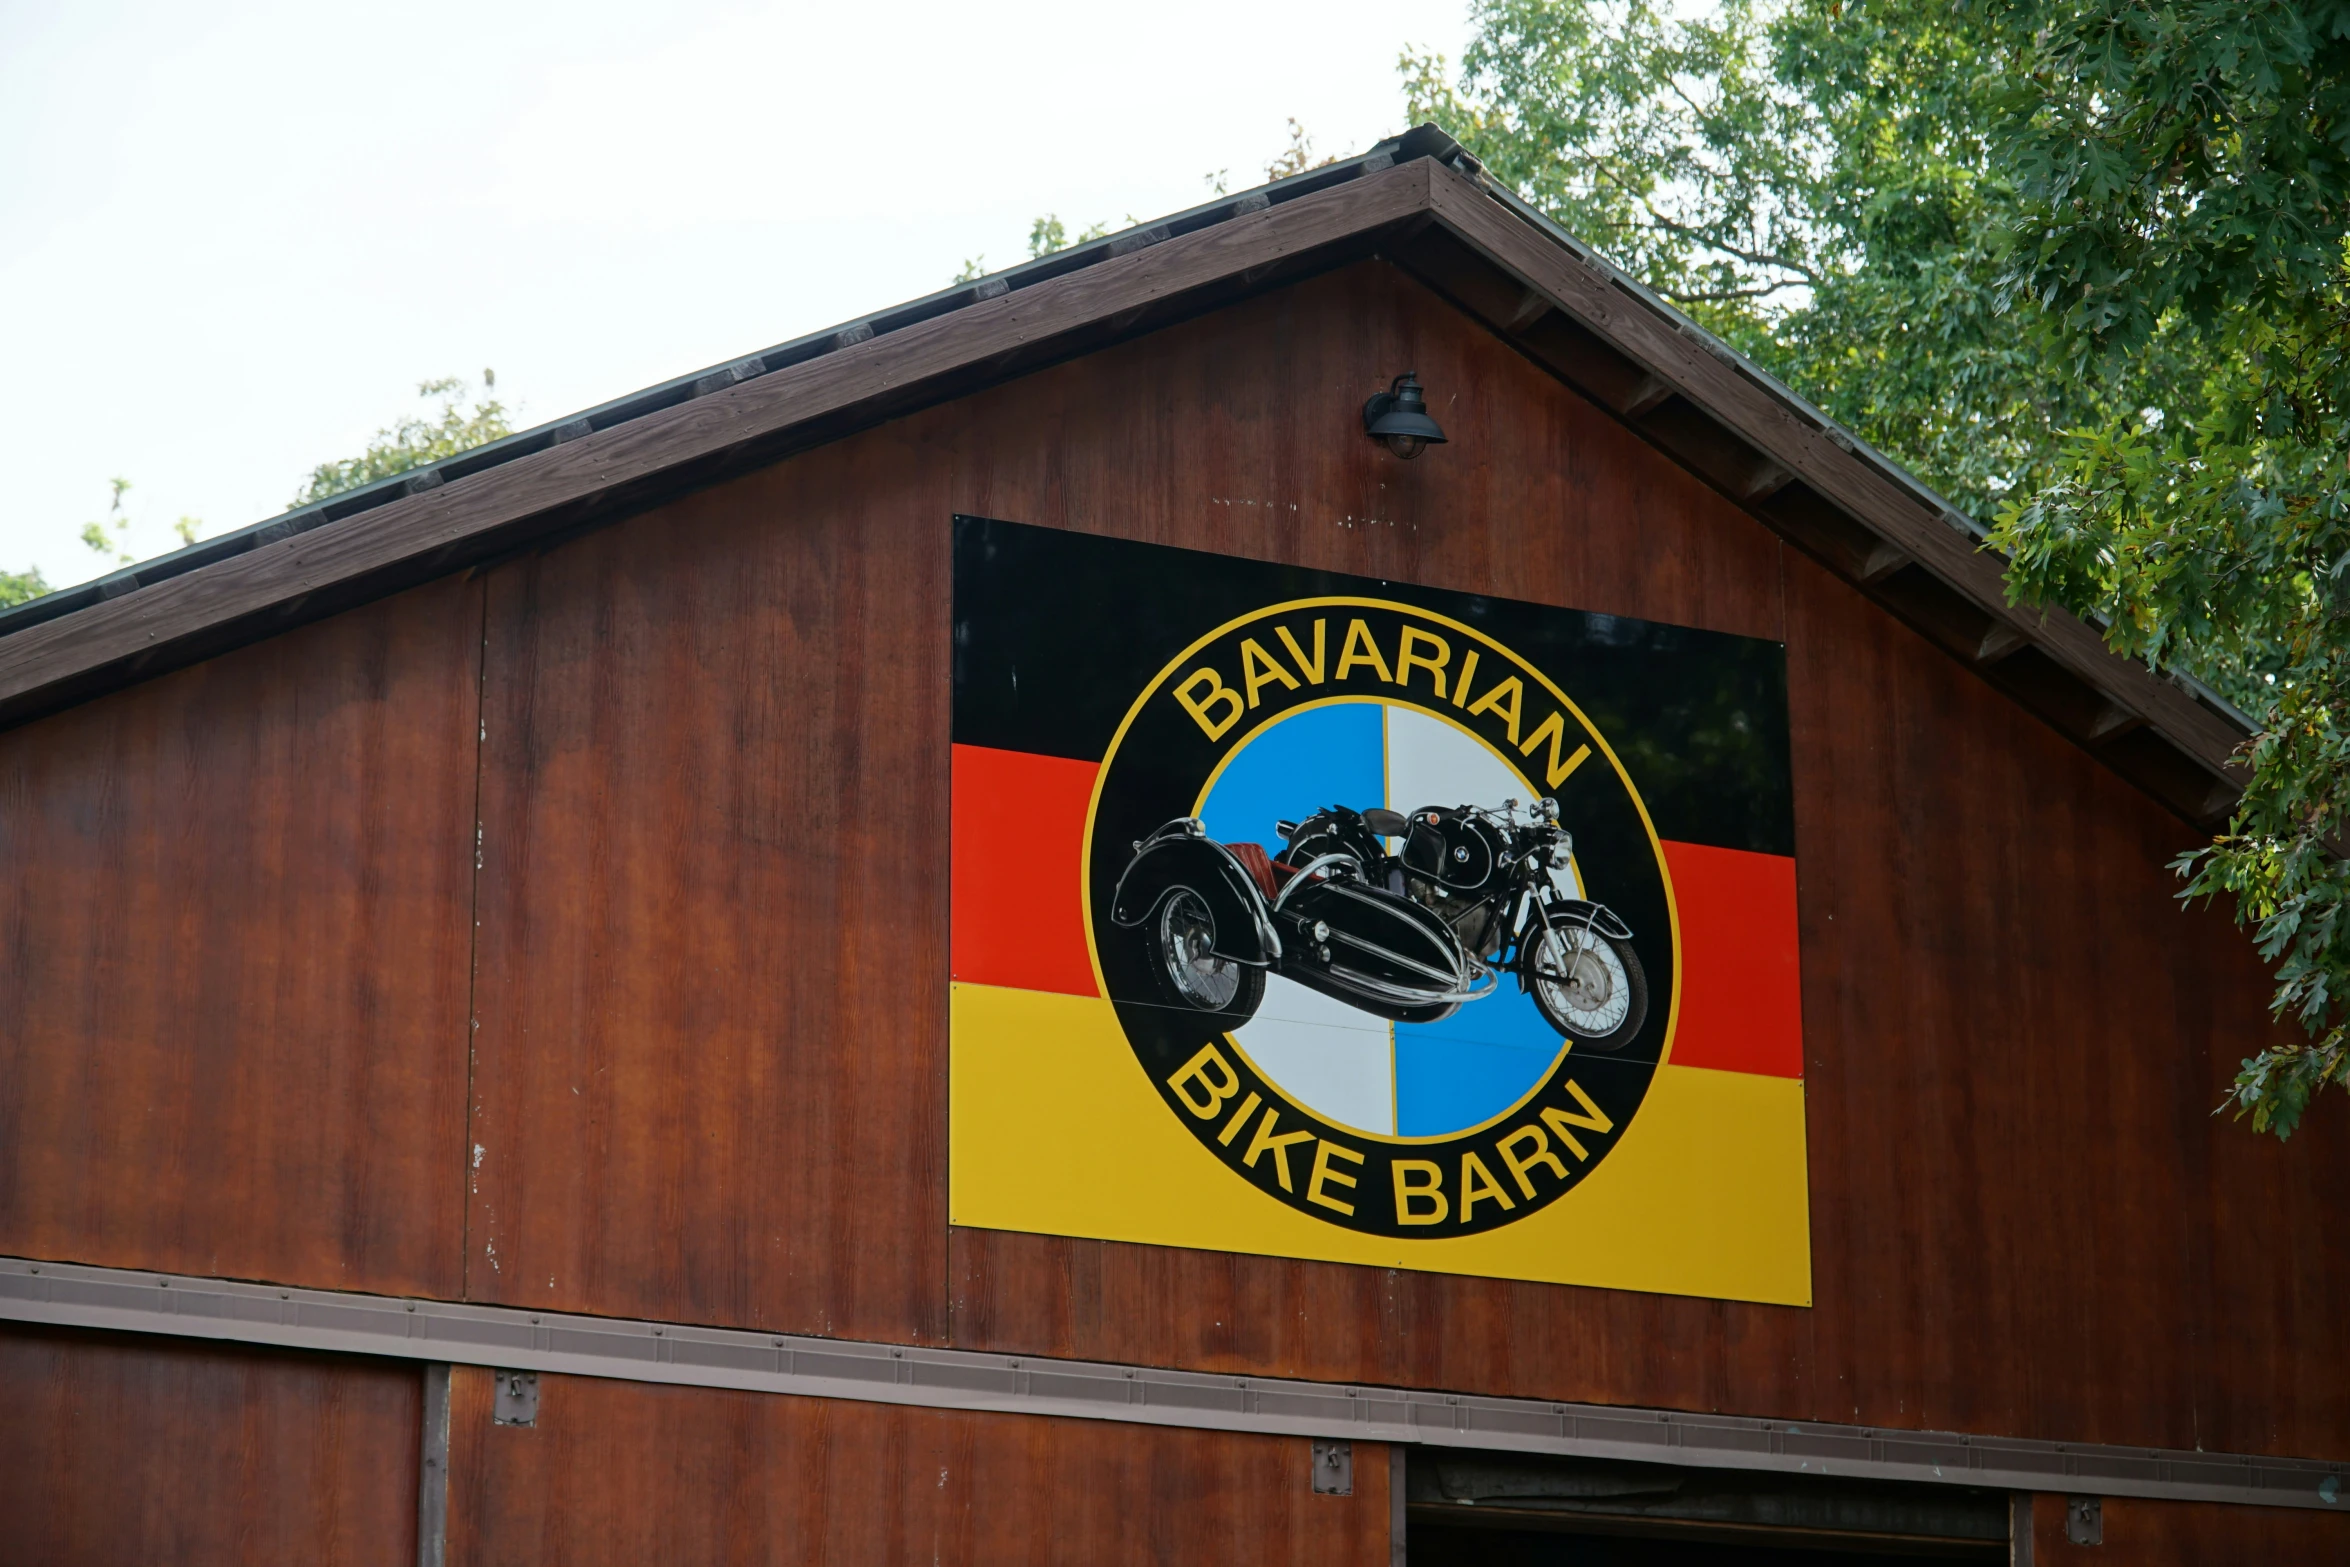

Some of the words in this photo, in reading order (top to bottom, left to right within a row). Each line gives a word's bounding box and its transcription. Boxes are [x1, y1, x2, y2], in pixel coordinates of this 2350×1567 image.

[1172, 618, 1592, 790] BAVARIAN
[1167, 1042, 1365, 1217] BIKE
[1391, 1079, 1614, 1226] BARN
